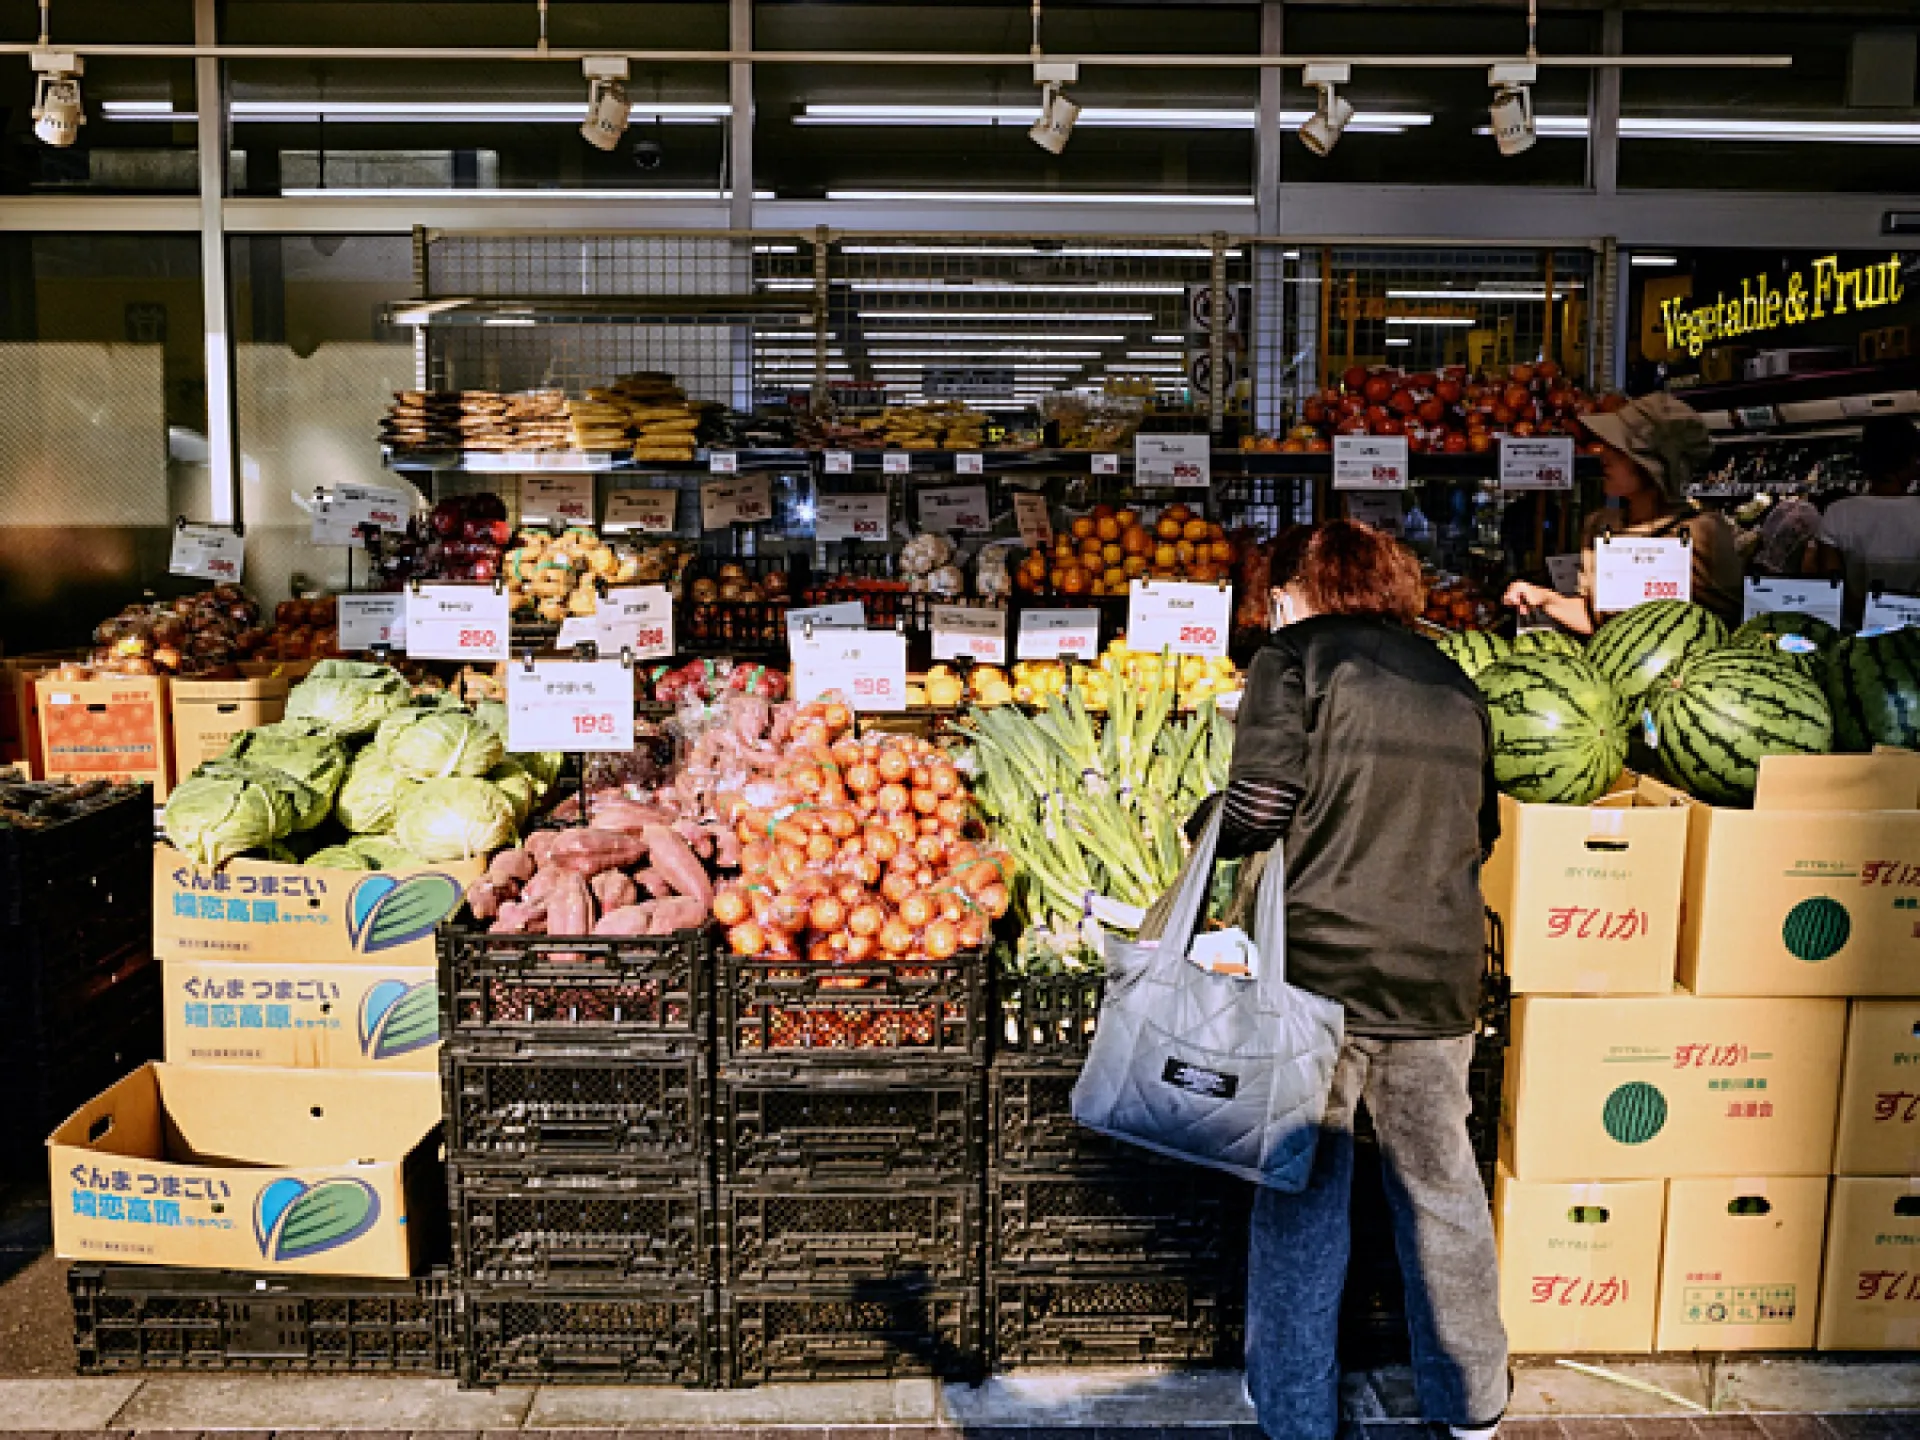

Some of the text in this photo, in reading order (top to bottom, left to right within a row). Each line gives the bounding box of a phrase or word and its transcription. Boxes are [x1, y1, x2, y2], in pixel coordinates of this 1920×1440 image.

[1661, 272, 1781, 358] Vegetable
[1811, 252, 1905, 321] Fruit
[458, 629, 496, 648] 250
[1547, 905, 1649, 940] すいか
[1674, 1043, 1748, 1069] すいか
[1531, 1274, 1629, 1307] すいか
